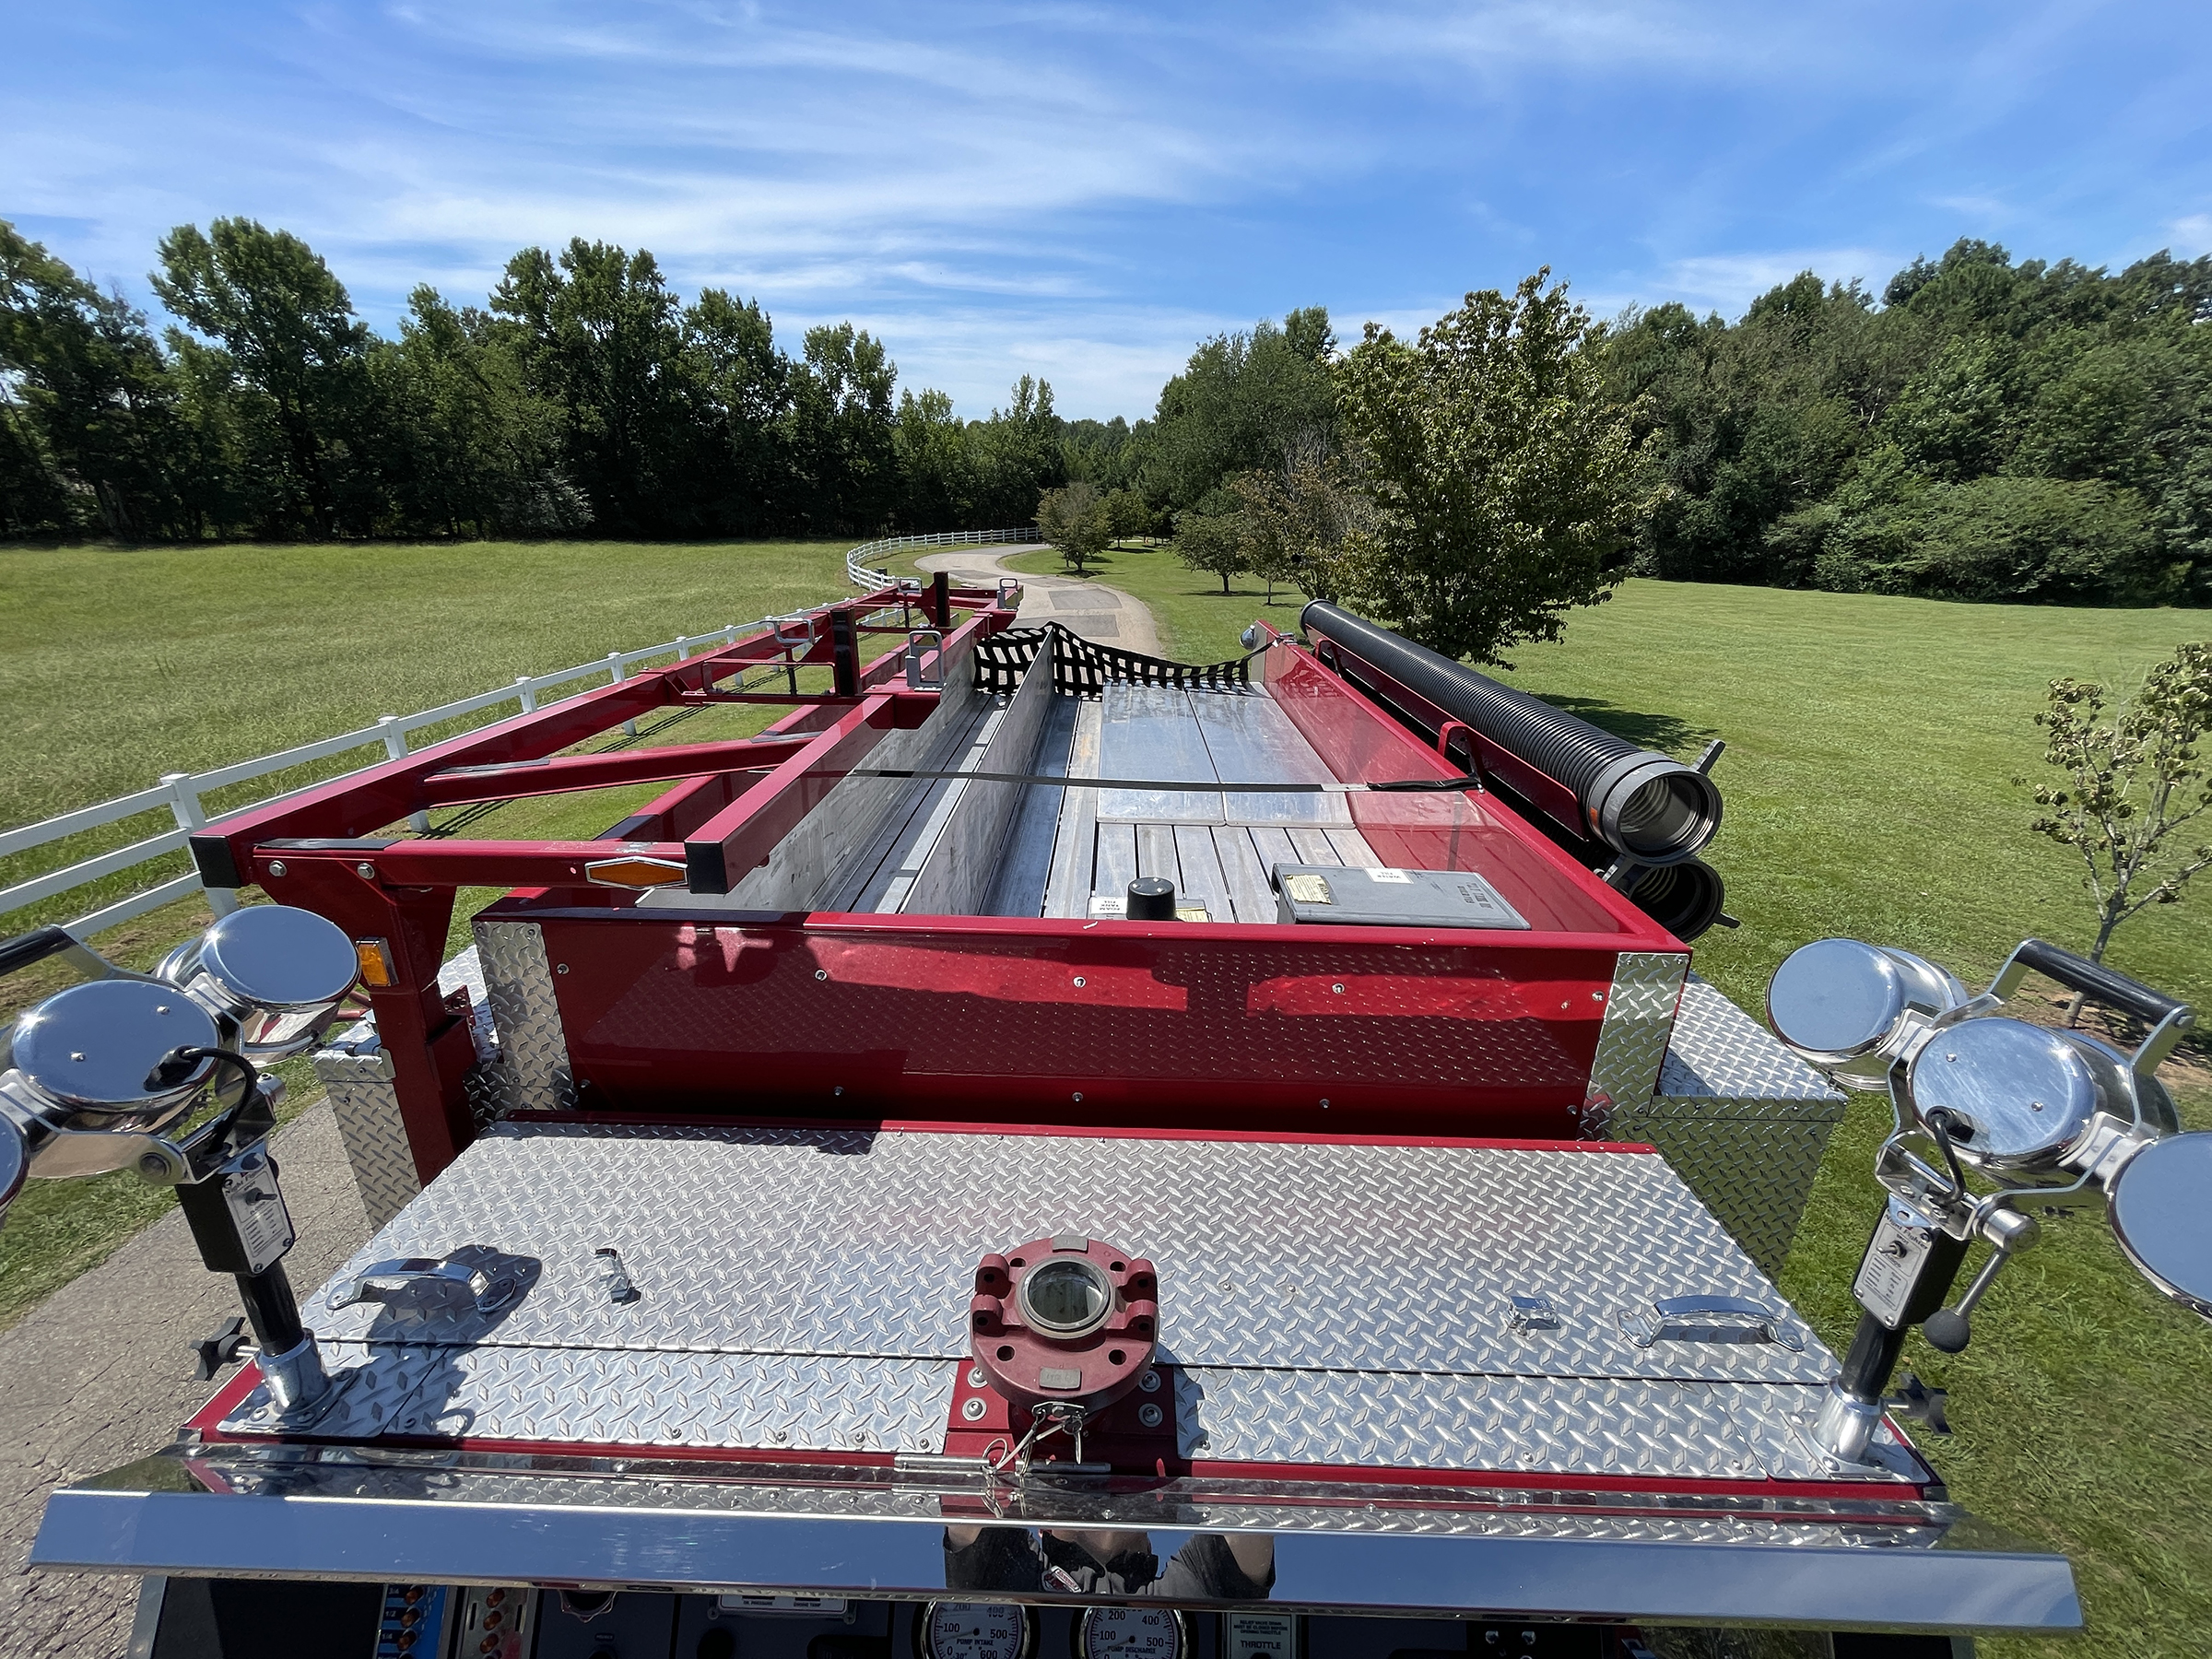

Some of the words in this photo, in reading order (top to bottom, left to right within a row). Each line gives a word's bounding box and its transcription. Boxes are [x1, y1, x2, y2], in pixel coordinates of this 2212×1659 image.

[1896, 1233, 1910, 1245] SPOT
[1902, 1227, 1928, 1250] Fighter
[1108, 1610, 1125, 1620] 200
[1141, 1615, 1159, 1626] 400
[943, 1622, 960, 1632] 100
[990, 1629, 1008, 1639] 500
[1100, 1630, 1116, 1641] 100
[1146, 1637, 1164, 1647] 500
[1241, 1640, 1281, 1650] THROTTLE
[947, 1645, 953, 1656] 0
[980, 1650, 998, 1659] 600
[1124, 1646, 1156, 1654] DISCHARGE
